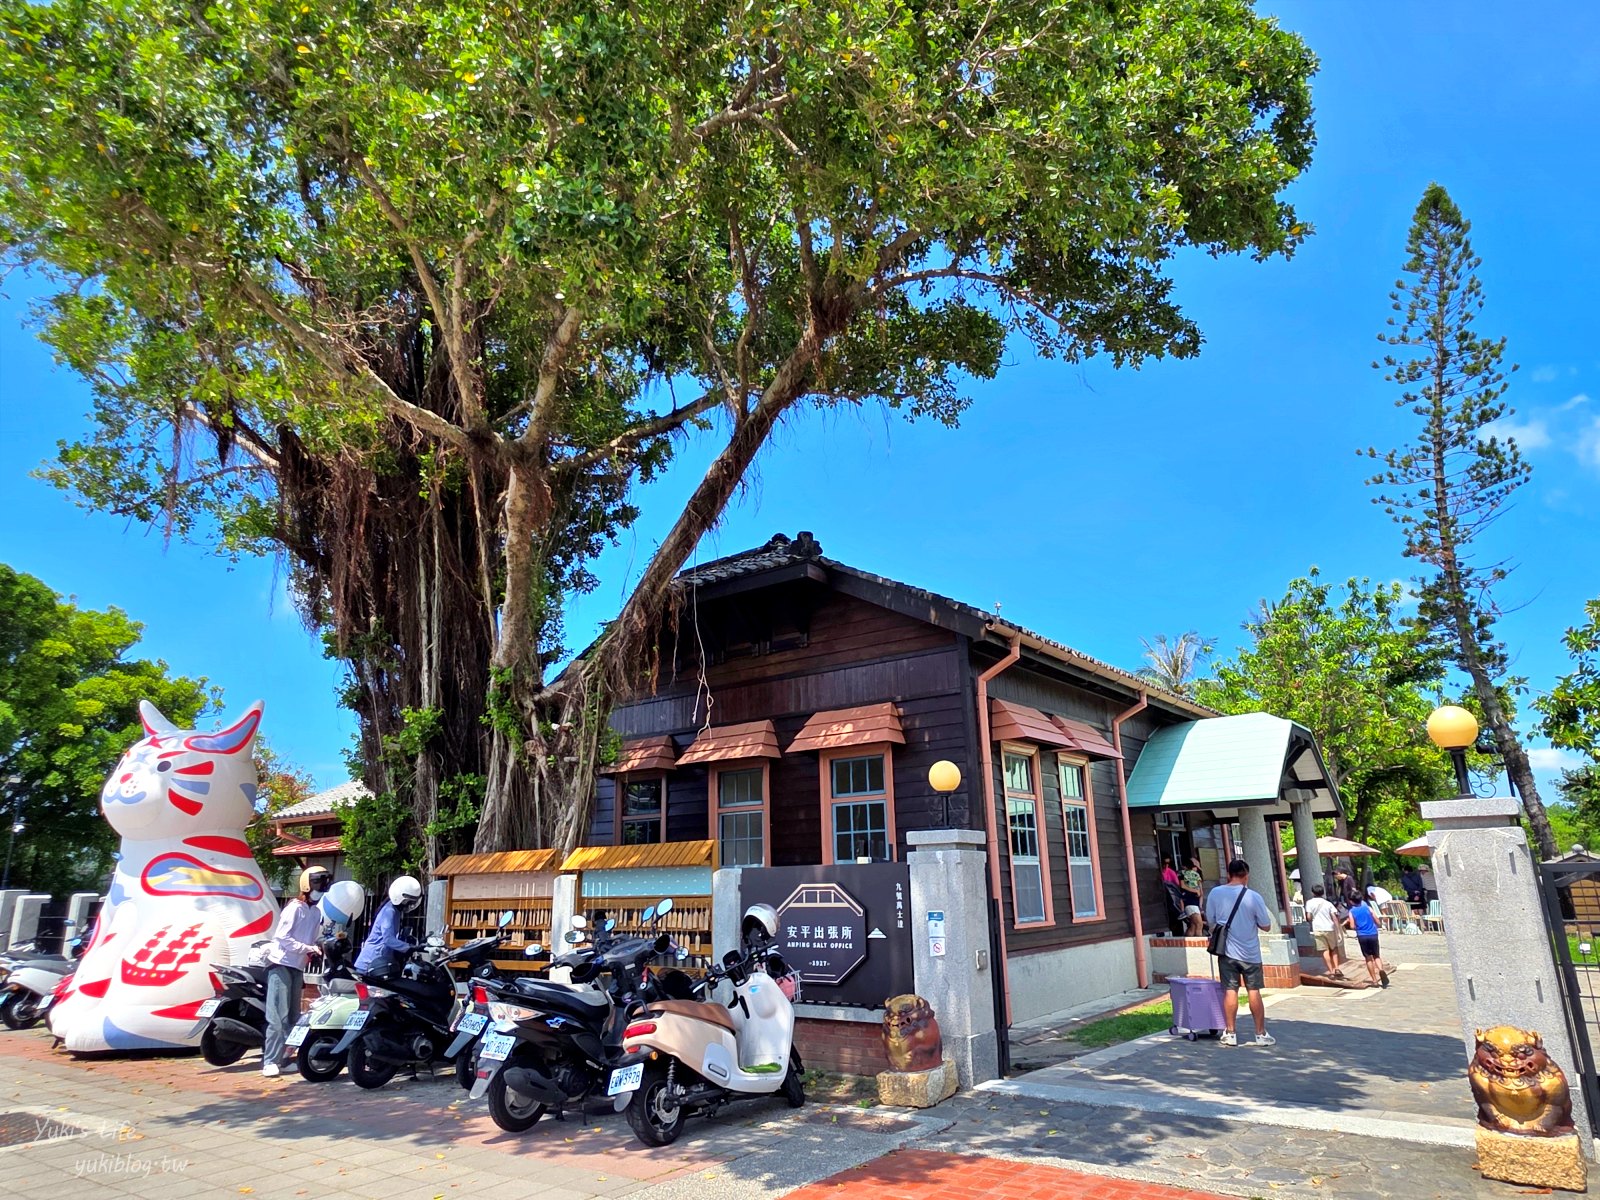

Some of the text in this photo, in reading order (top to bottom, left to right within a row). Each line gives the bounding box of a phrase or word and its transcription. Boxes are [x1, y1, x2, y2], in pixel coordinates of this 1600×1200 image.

[786, 925, 853, 940] 安平出張所
[786, 941, 811, 949] ANPING
[829, 942, 853, 950] OFFICE
